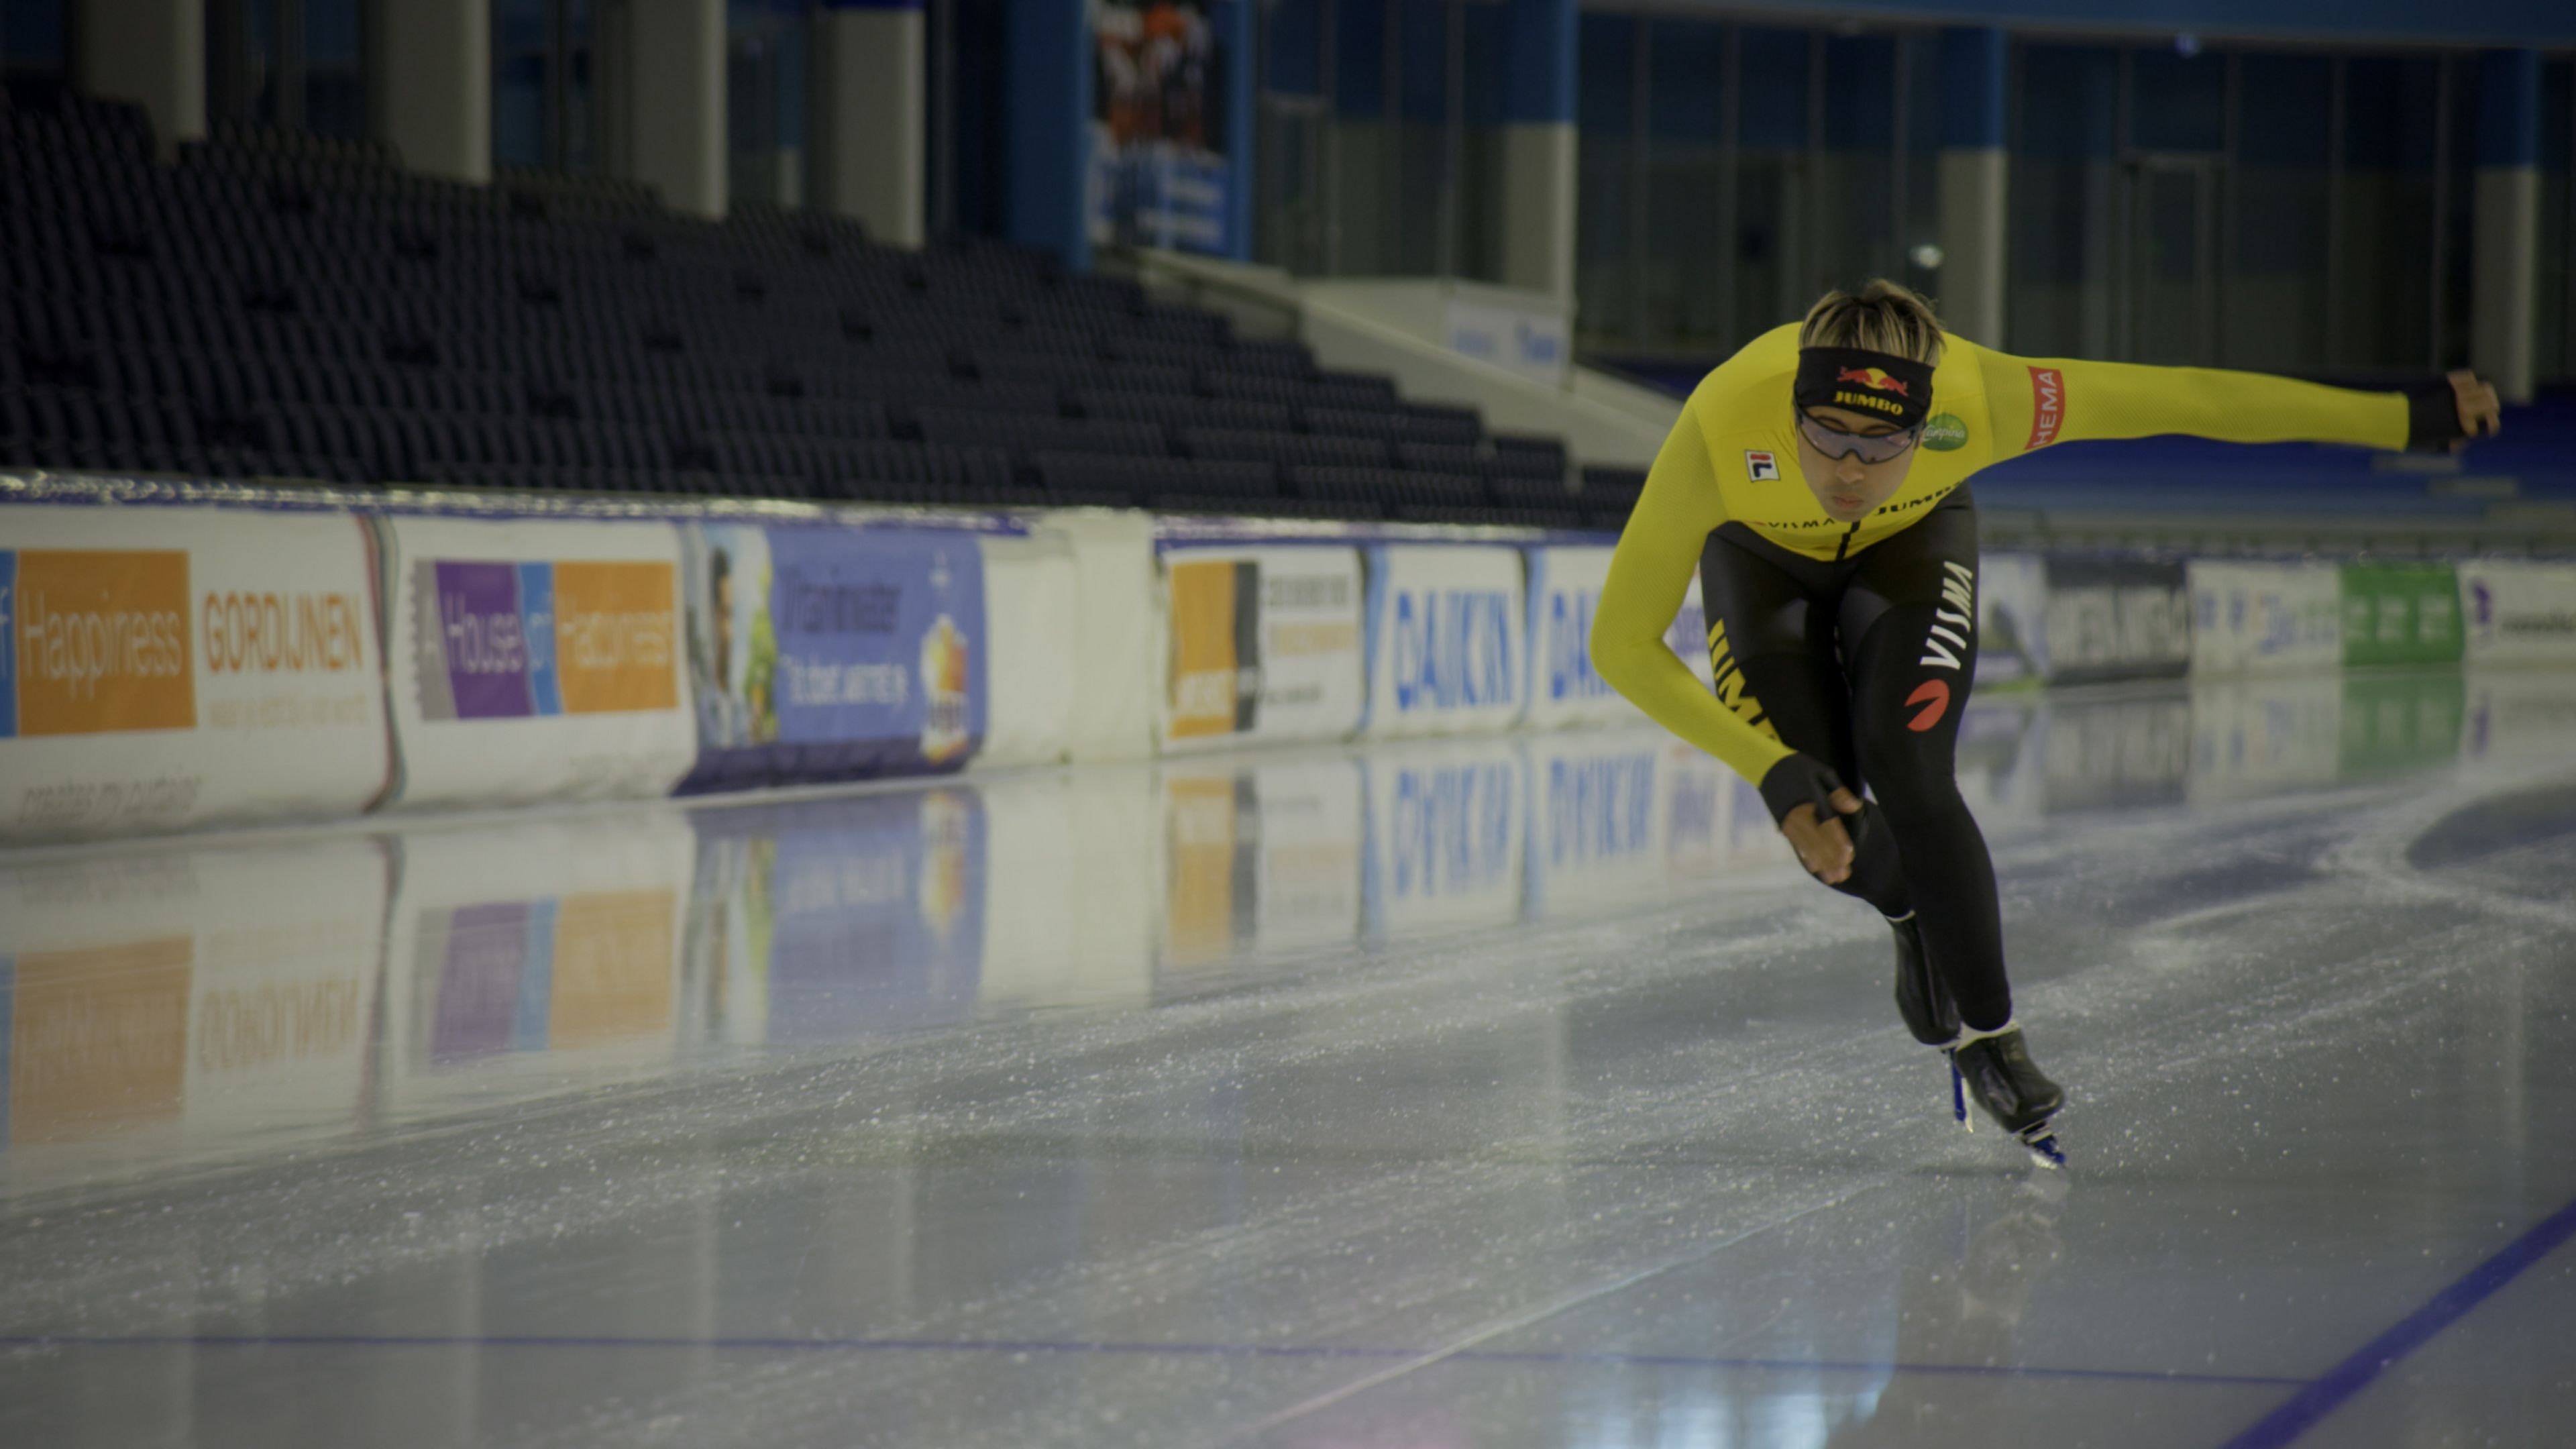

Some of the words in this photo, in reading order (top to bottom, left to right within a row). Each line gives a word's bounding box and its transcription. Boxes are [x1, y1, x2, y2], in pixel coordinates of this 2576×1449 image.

[1833, 390, 1904, 416] JUMBO
[1923, 423, 1966, 441] Campina
[2033, 371, 2058, 447] HEMA
[23, 590, 182, 699] Happiness
[205, 592, 363, 674] GORDIJNEN
[1919, 560, 1974, 671] VISMA
